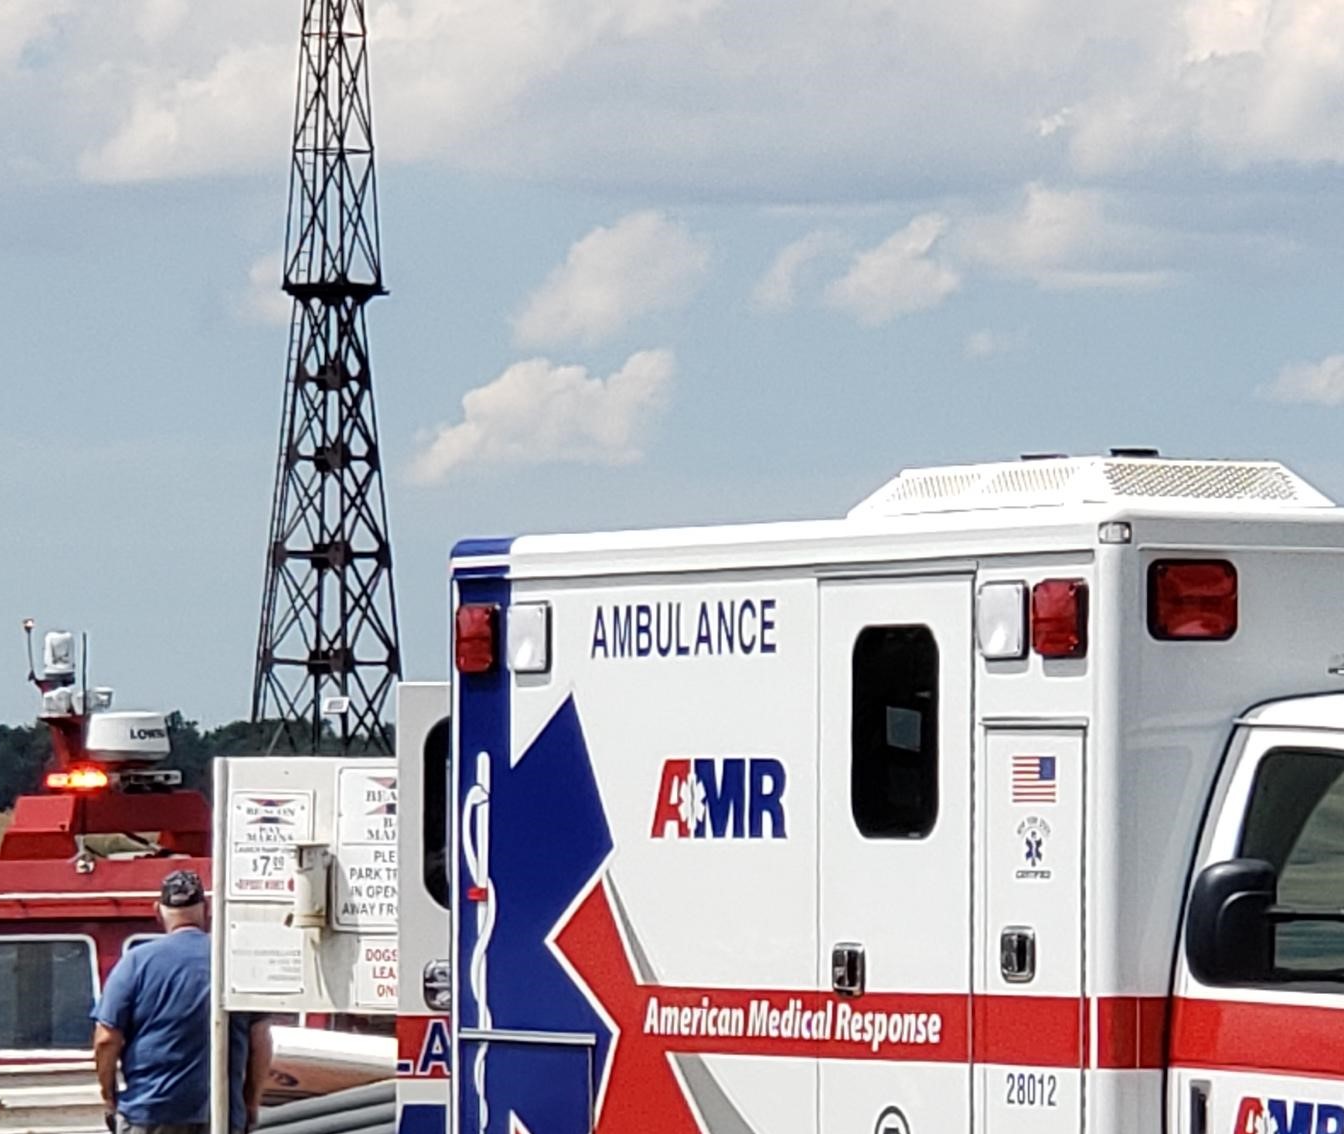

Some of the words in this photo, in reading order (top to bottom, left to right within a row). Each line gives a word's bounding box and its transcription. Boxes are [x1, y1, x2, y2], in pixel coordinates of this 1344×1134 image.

[590, 598, 777, 660] AMBULANCE
[650, 758, 788, 840] AMR
[349, 867, 383, 880] PARK
[342, 902, 376, 915] AWAY
[643, 996, 744, 1036] American
[746, 997, 834, 1039] Medical
[835, 1002, 942, 1053] Response
[1006, 1072, 1057, 1107] 28012
